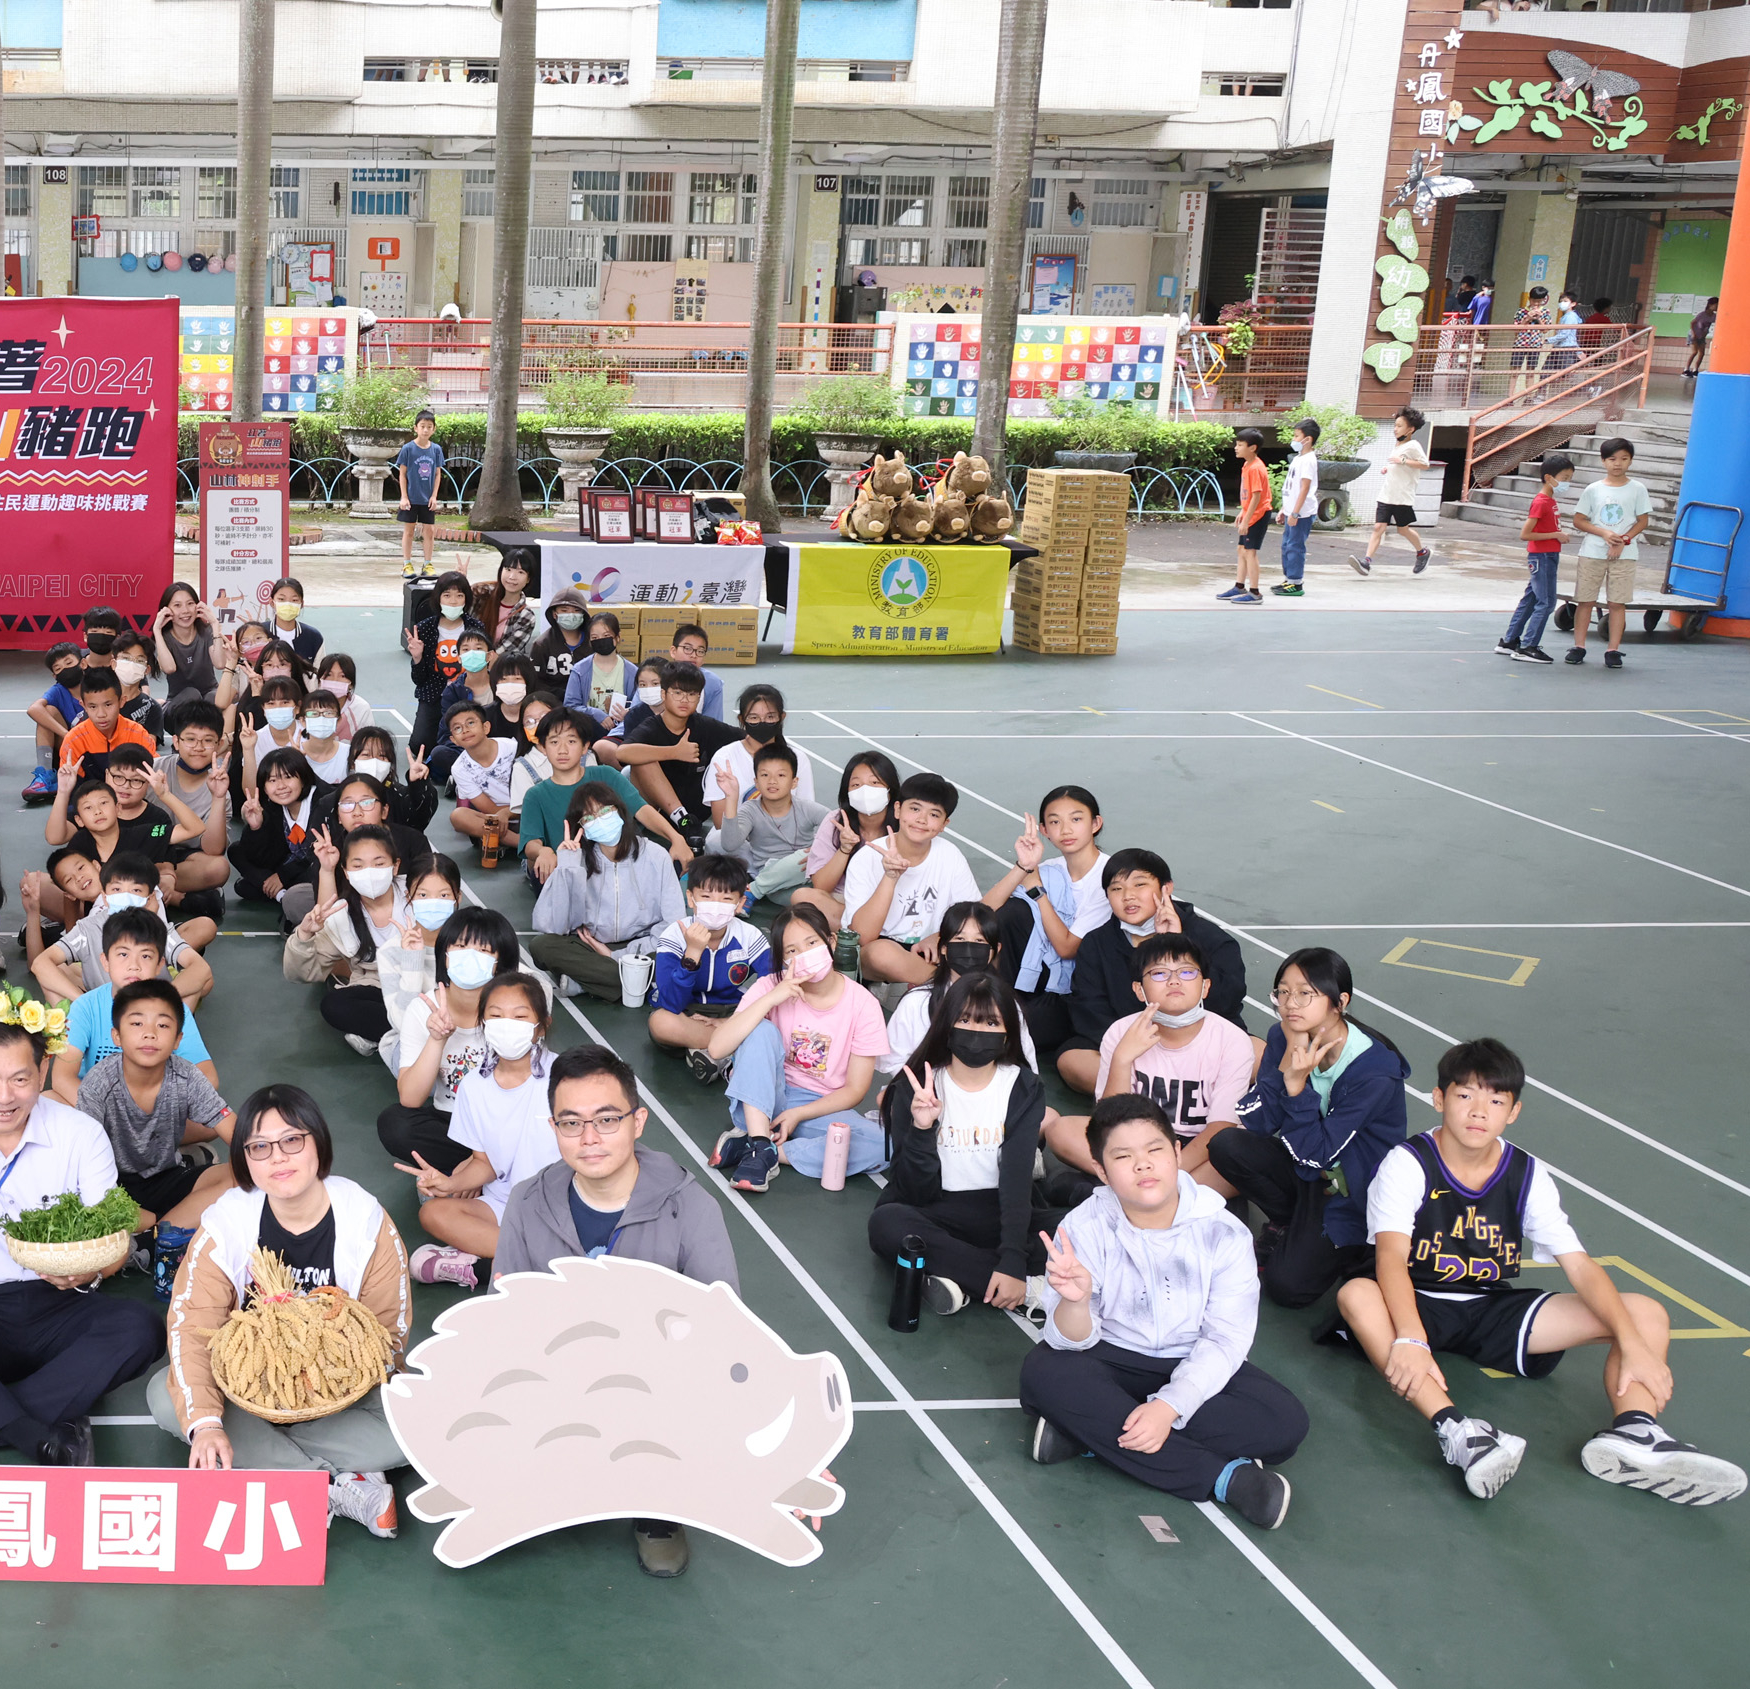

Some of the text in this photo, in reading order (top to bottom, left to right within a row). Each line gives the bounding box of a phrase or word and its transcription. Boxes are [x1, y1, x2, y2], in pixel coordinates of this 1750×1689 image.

[1413, 42, 1447, 162] 丹鳳國小
[816, 177, 837, 188] 107
[1379, 266, 1413, 369] 幼兒園
[38, 355, 153, 395] 2024
[209, 473, 280, 487] 山林神射手
[79, 573, 143, 597] CITY
[870, 548, 937, 603] MINISTRY OF EDUCATION
[881, 600, 924, 618] 教育部
[852, 624, 949, 641] 教育部體育署
[811, 640, 837, 650] Sports
[905, 644, 936, 653] Ministry
[938, 643, 947, 652] of
[948, 644, 988, 652] Education
